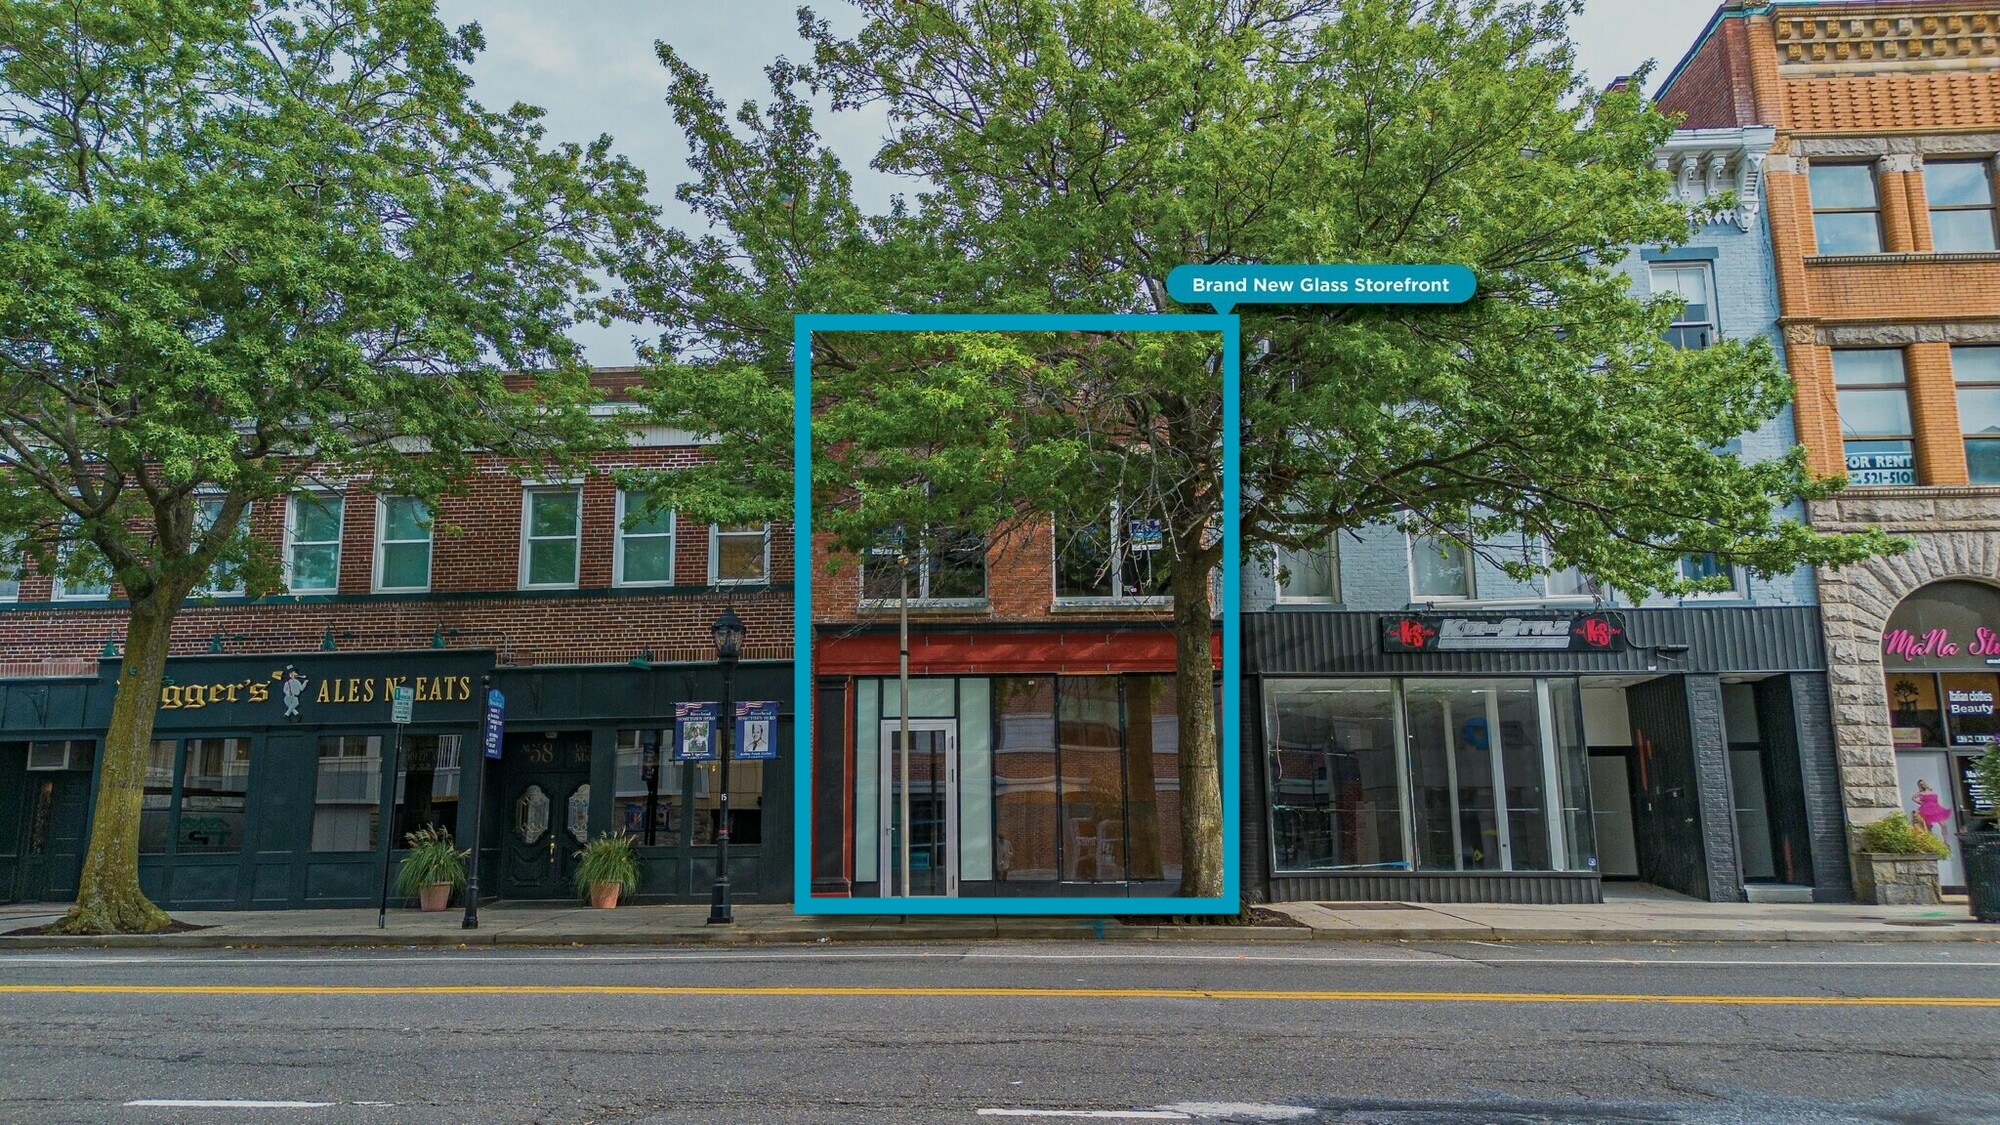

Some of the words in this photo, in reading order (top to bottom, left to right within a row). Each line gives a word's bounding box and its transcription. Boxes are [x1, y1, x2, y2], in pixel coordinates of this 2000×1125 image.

[1875, 455, 1913, 468] RENT
[1864, 471, 1911, 484] 521-510
[1883, 628, 1959, 662] MaNa
[1968, 626, 2000, 656] Stu
[116, 679, 272, 710] gger's
[317, 678, 375, 703] ALES
[415, 676, 471, 701] EATS
[1951, 703, 1994, 715] Beauty
[530, 742, 553, 763] 58
